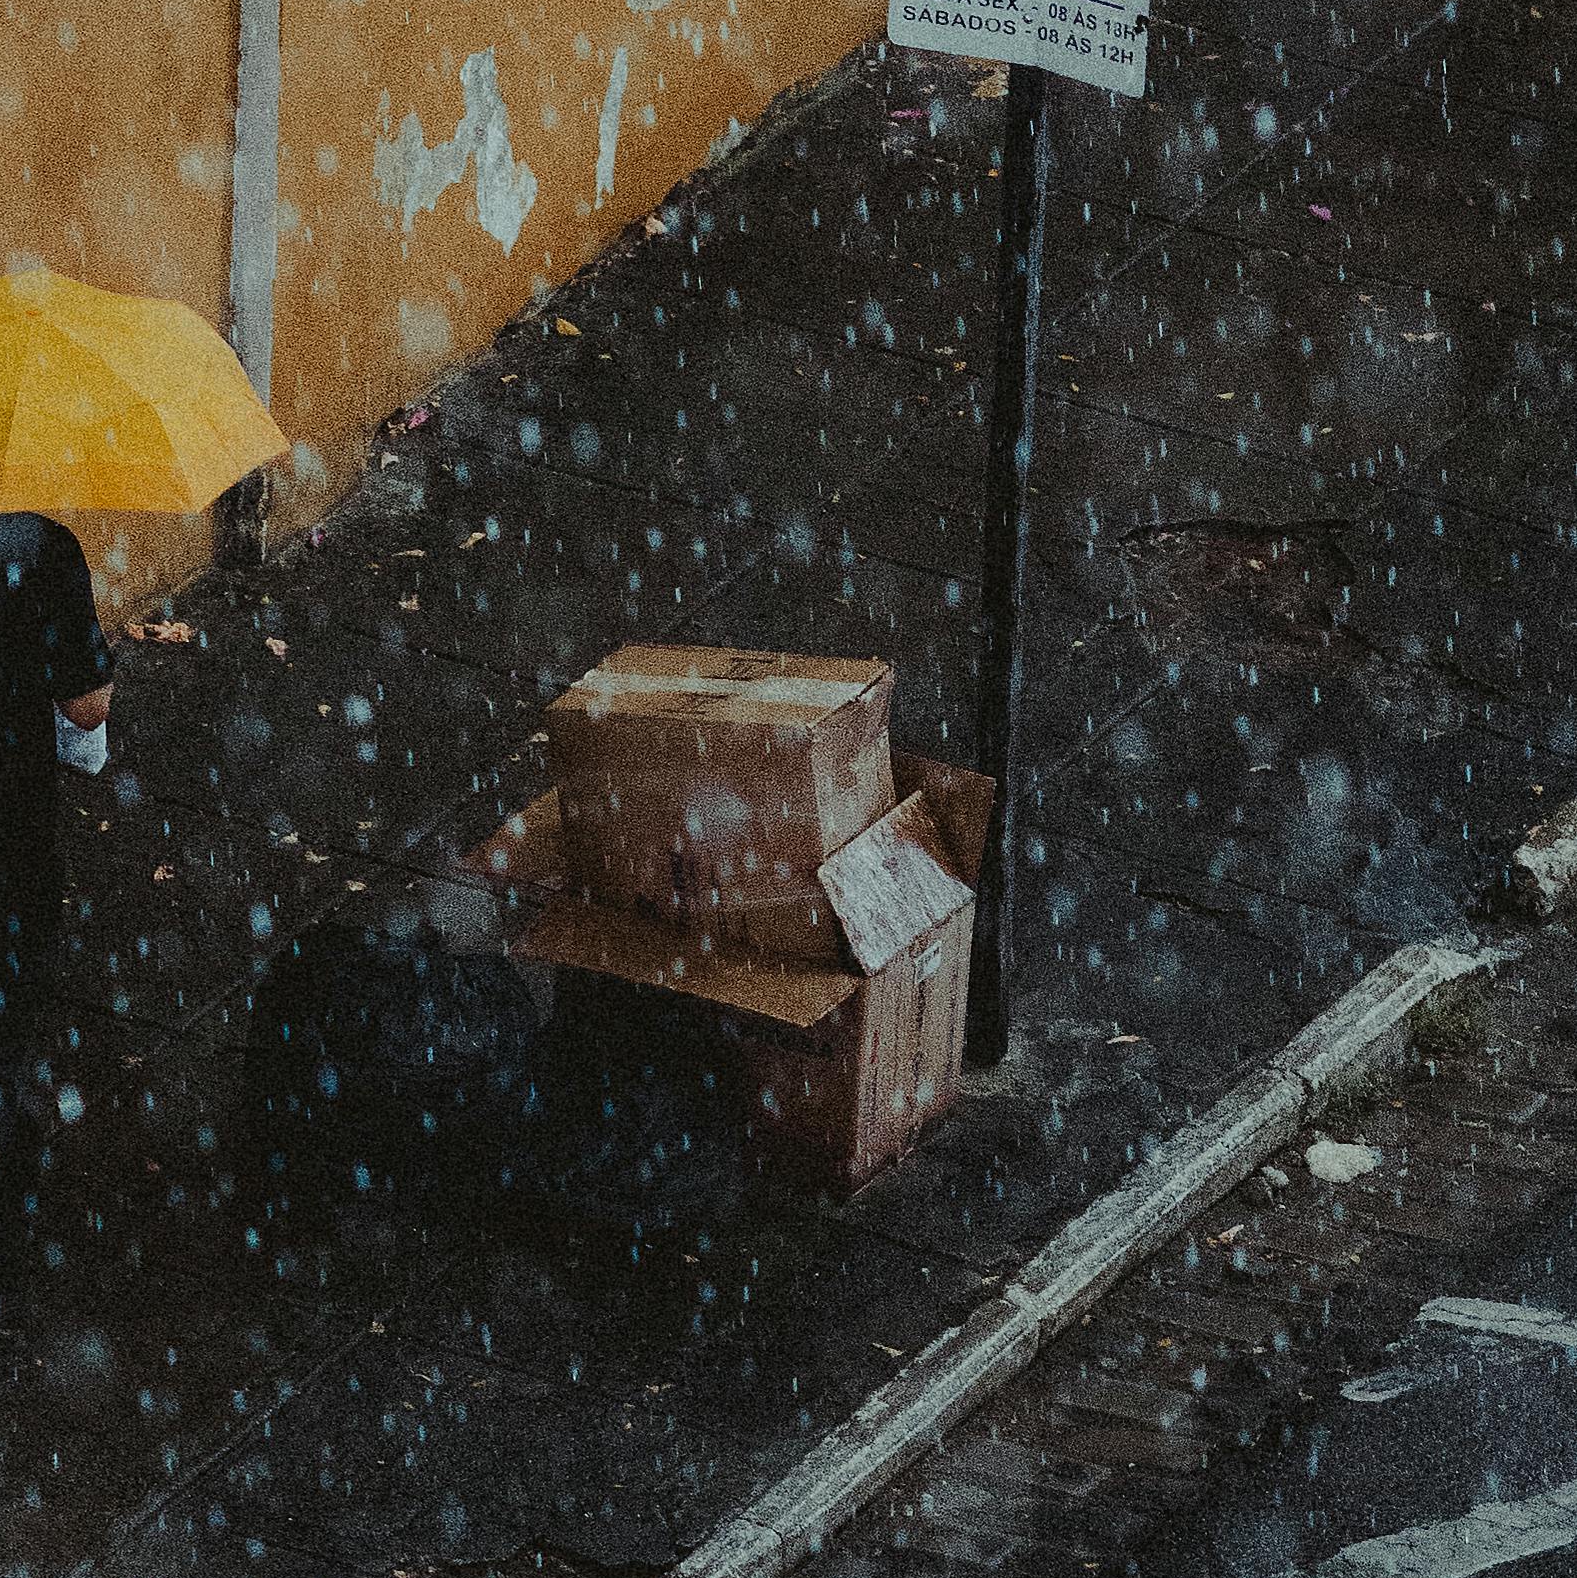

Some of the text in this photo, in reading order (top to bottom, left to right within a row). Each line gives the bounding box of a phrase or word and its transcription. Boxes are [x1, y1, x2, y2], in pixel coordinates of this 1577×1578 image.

[1048, 2, 1068, 23] 08
[903, 3, 1017, 36] SÁBADOS
[1037, 25, 1060, 45] 08
[1100, 43, 1134, 66] 12H
